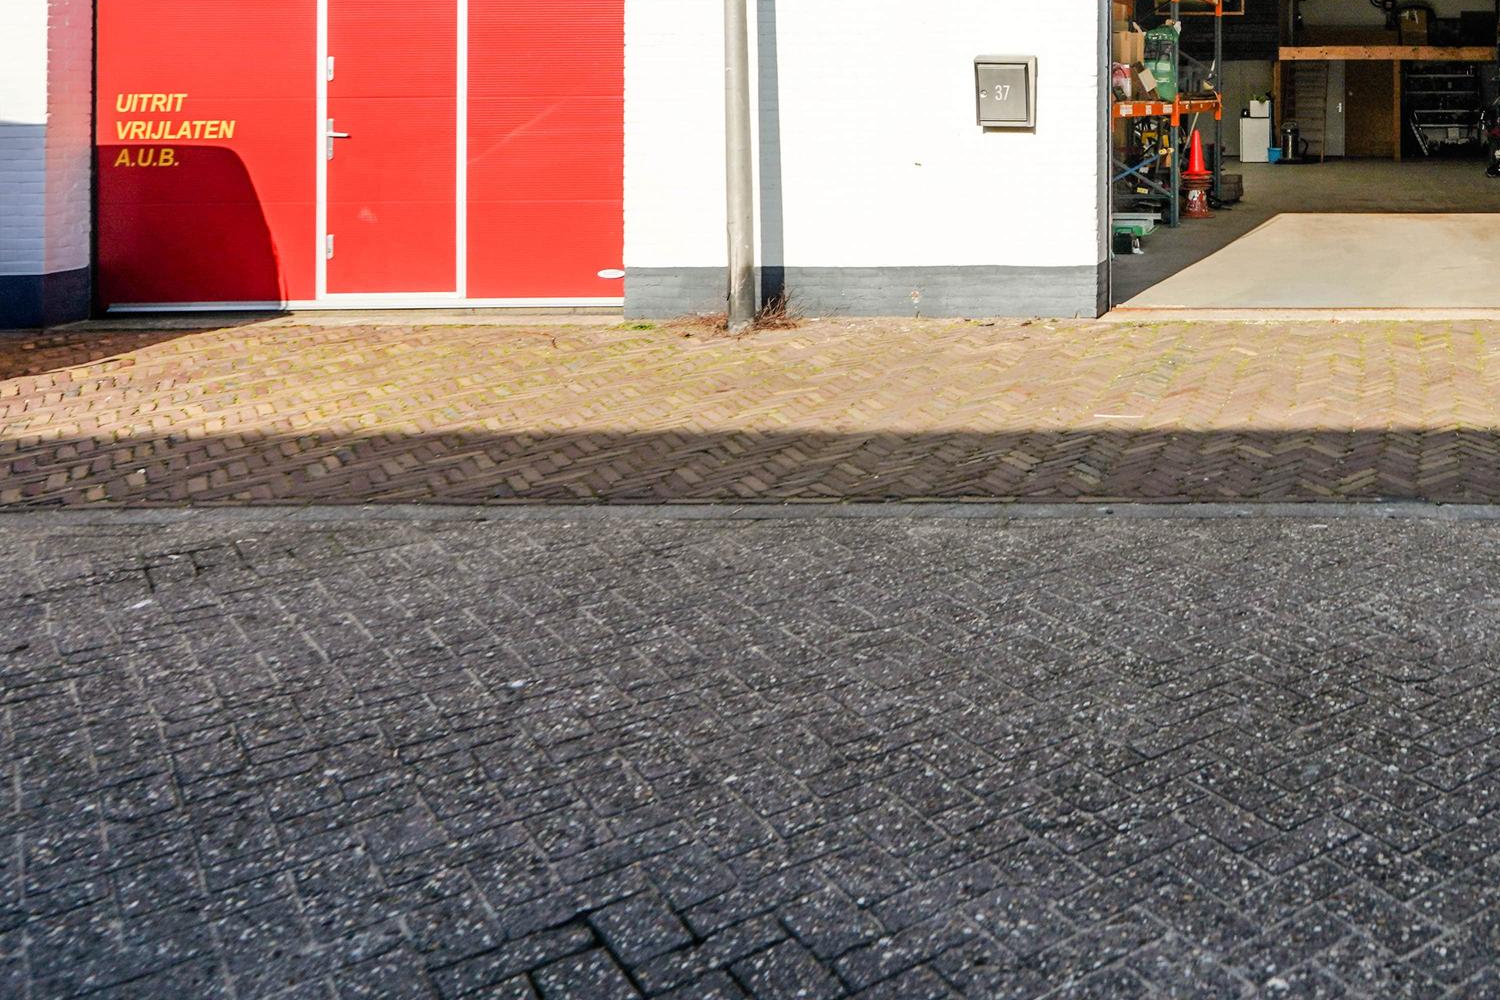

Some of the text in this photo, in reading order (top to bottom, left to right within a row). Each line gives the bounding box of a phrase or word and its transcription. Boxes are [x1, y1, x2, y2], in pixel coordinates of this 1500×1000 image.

[995, 85, 1010, 101] 37
[116, 94, 188, 112] UITRIT
[116, 120, 236, 139] VRIJLATEN
[114, 148, 180, 167] A.U.B.
